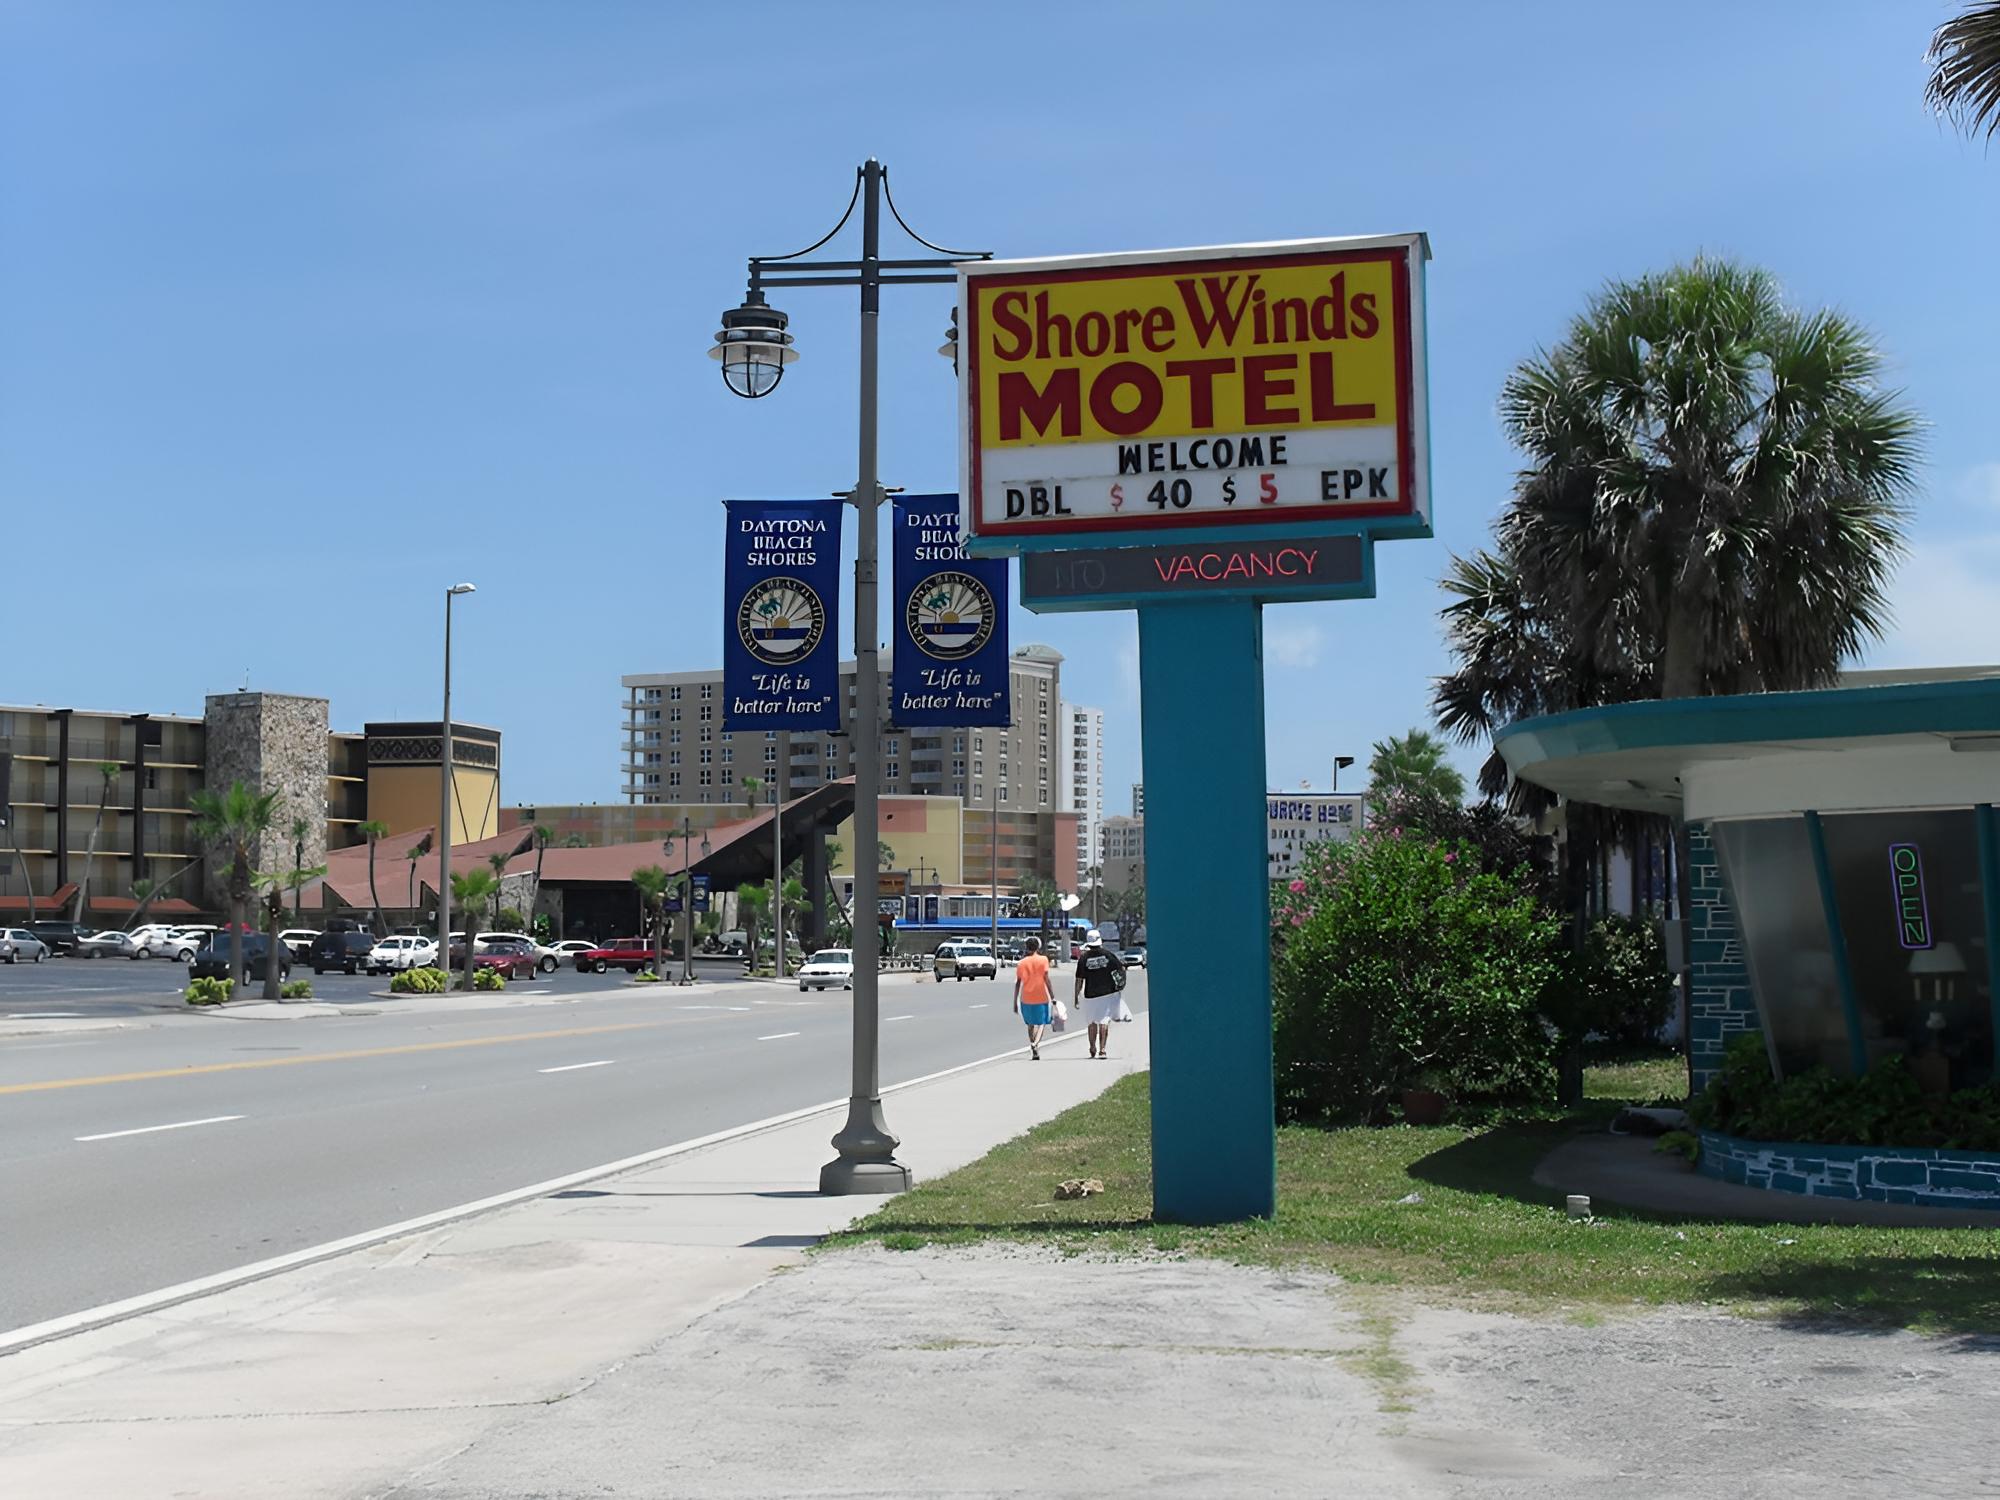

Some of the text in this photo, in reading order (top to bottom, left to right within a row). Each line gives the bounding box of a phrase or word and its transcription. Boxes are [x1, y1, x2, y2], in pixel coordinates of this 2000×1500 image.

[992, 271, 1380, 362] Shore Winds
[998, 351, 1376, 441] MOTEL
[1118, 436, 1288, 474] WELCOME
[1006, 468, 1389, 518] DBL $ 40 $ 5 EPK
[741, 520, 826, 532] DAYTONA
[754, 536, 812, 549] BEACH
[747, 552, 816, 566] SHORES
[1155, 548, 1317, 583] VACANCY
[797, 674, 810, 691] is
[967, 669, 981, 686] is
[734, 695, 778, 714] better
[902, 692, 951, 710] better
[1895, 849, 1925, 943] OPEN
